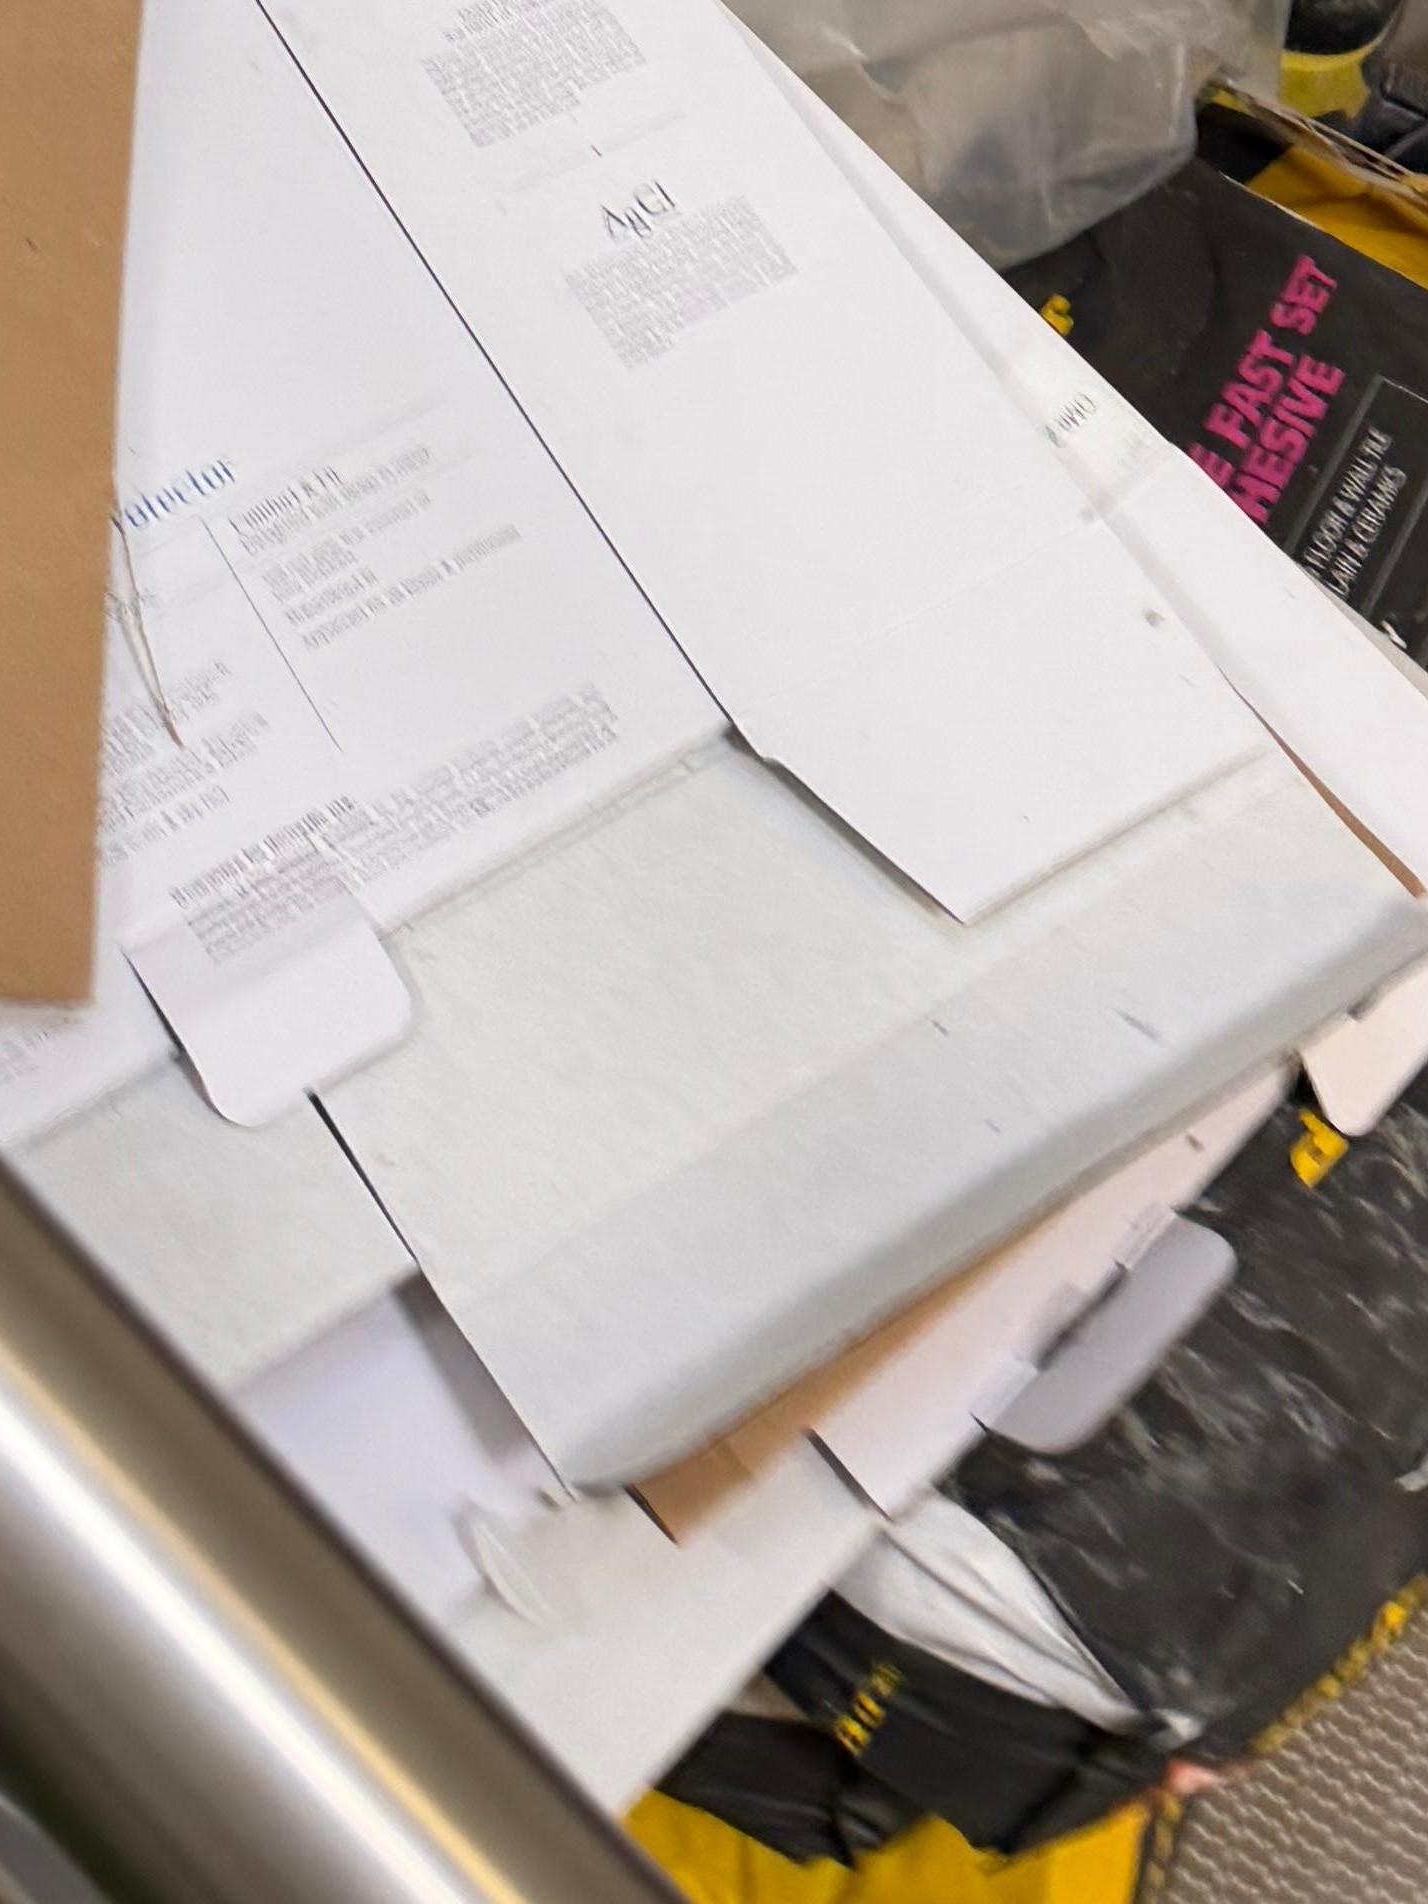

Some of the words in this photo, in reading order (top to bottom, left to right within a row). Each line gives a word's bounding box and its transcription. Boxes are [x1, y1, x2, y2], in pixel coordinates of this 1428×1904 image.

[1202, 328, 1296, 450] FAST
[1269, 253, 1339, 336] SET
[1227, 352, 1347, 525] HESIVE
